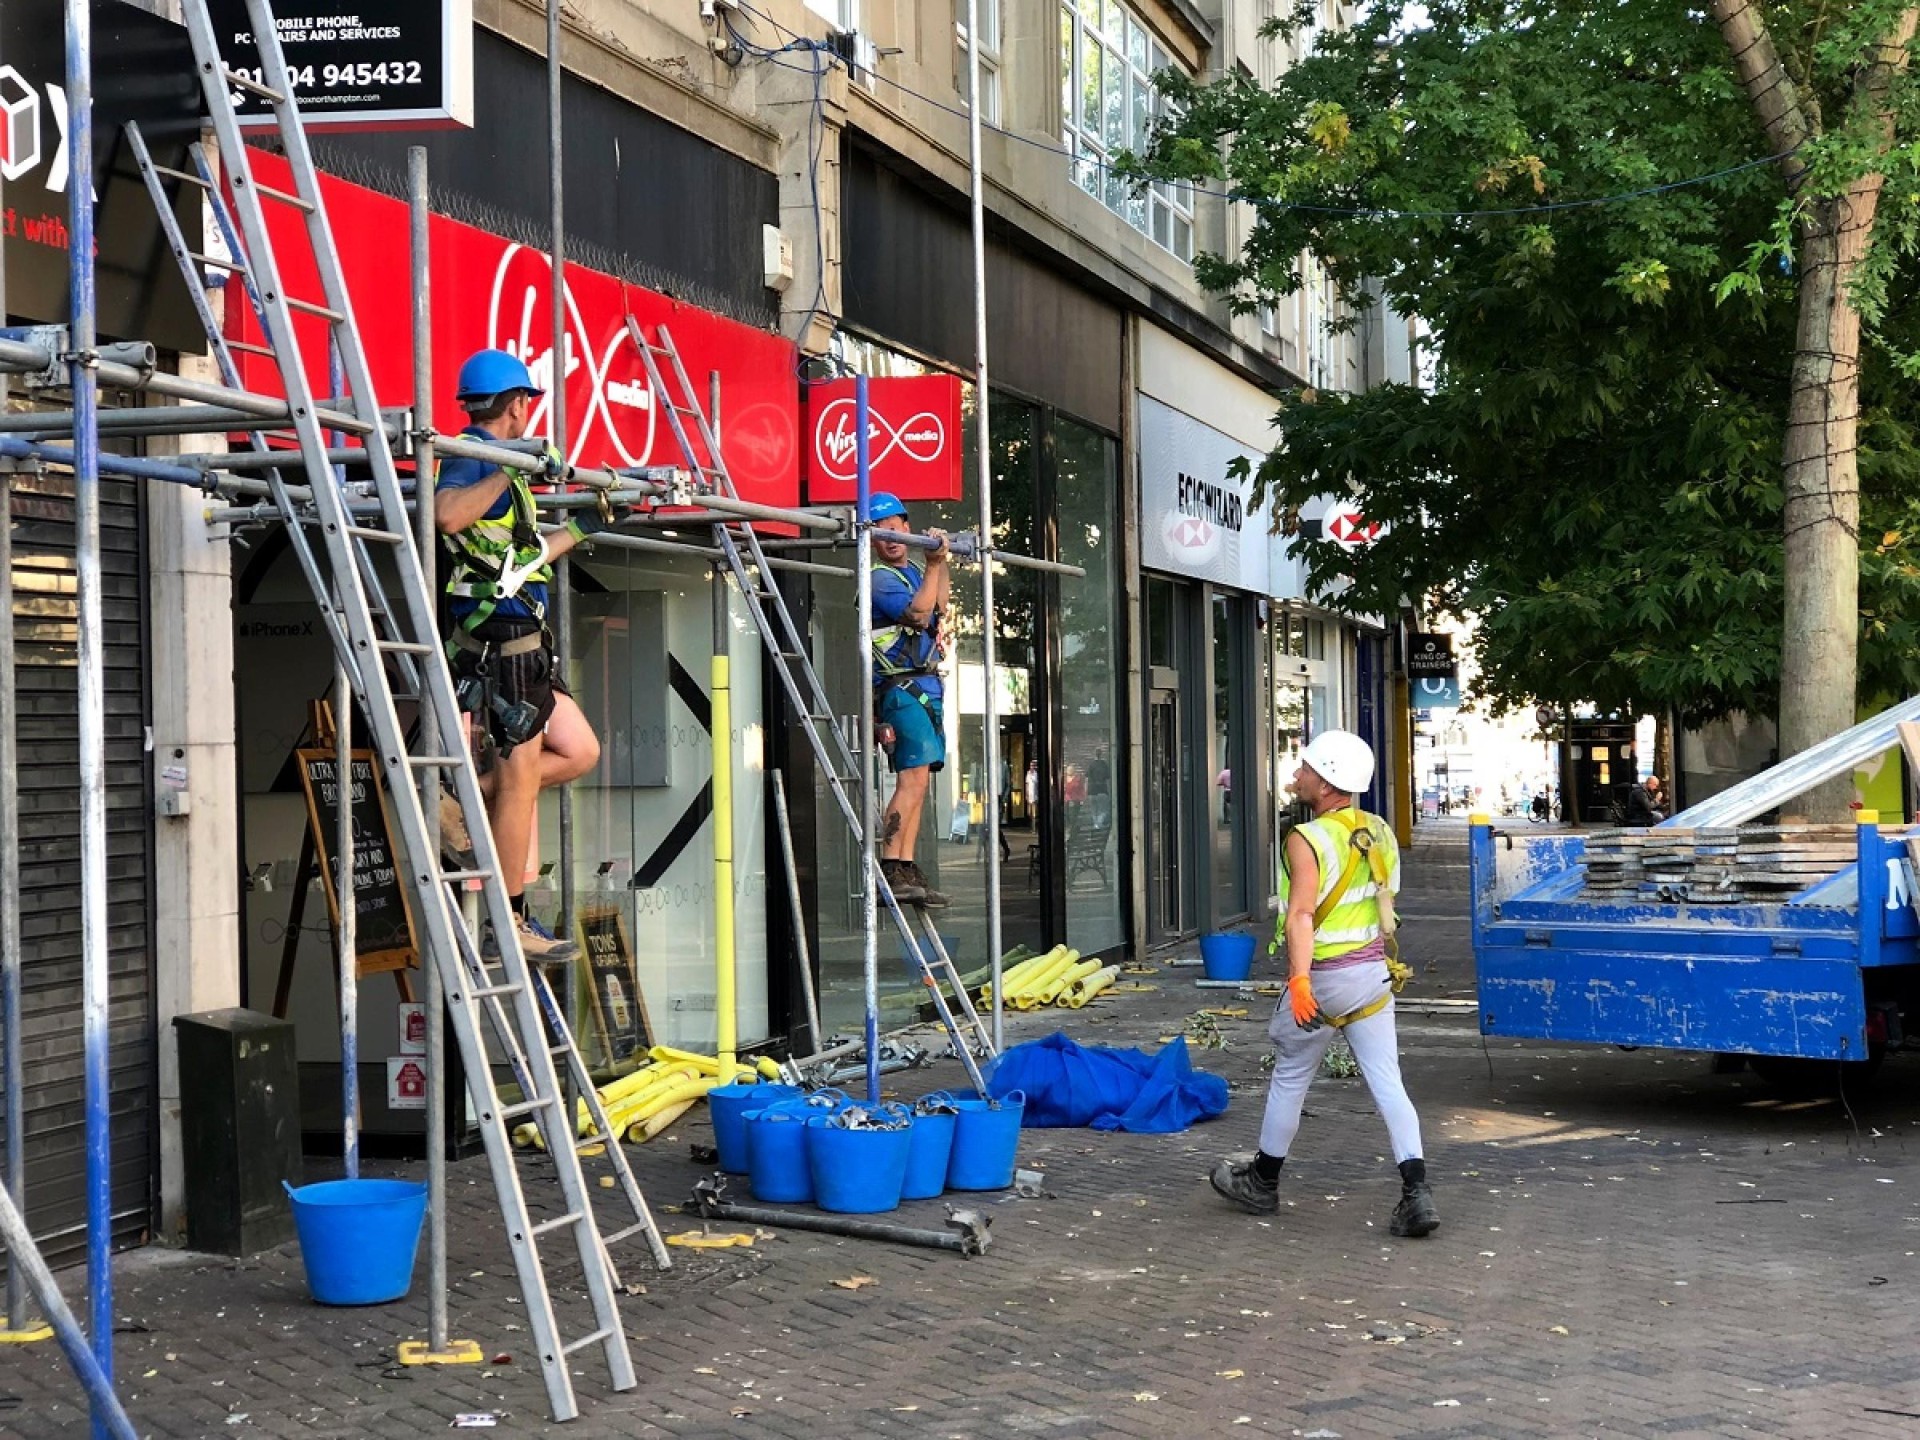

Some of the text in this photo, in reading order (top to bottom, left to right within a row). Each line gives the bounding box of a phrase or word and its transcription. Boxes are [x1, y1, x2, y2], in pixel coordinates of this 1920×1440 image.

[274, 16, 363, 30] OBILE PHONE,
[235, 33, 250, 44] PC
[309, 30, 337, 41] AND
[339, 26, 401, 40] SERVICES
[234, 61, 423, 90] 0104 945432
[22, 213, 69, 250] with
[607, 379, 650, 411] media
[904, 430, 939, 441] media
[1178, 472, 1243, 532] ECIGWIZARD
[250, 620, 313, 637] iPhone X
[1414, 652, 1448, 660] KING OF
[1411, 661, 1452, 670] TRAINERS
